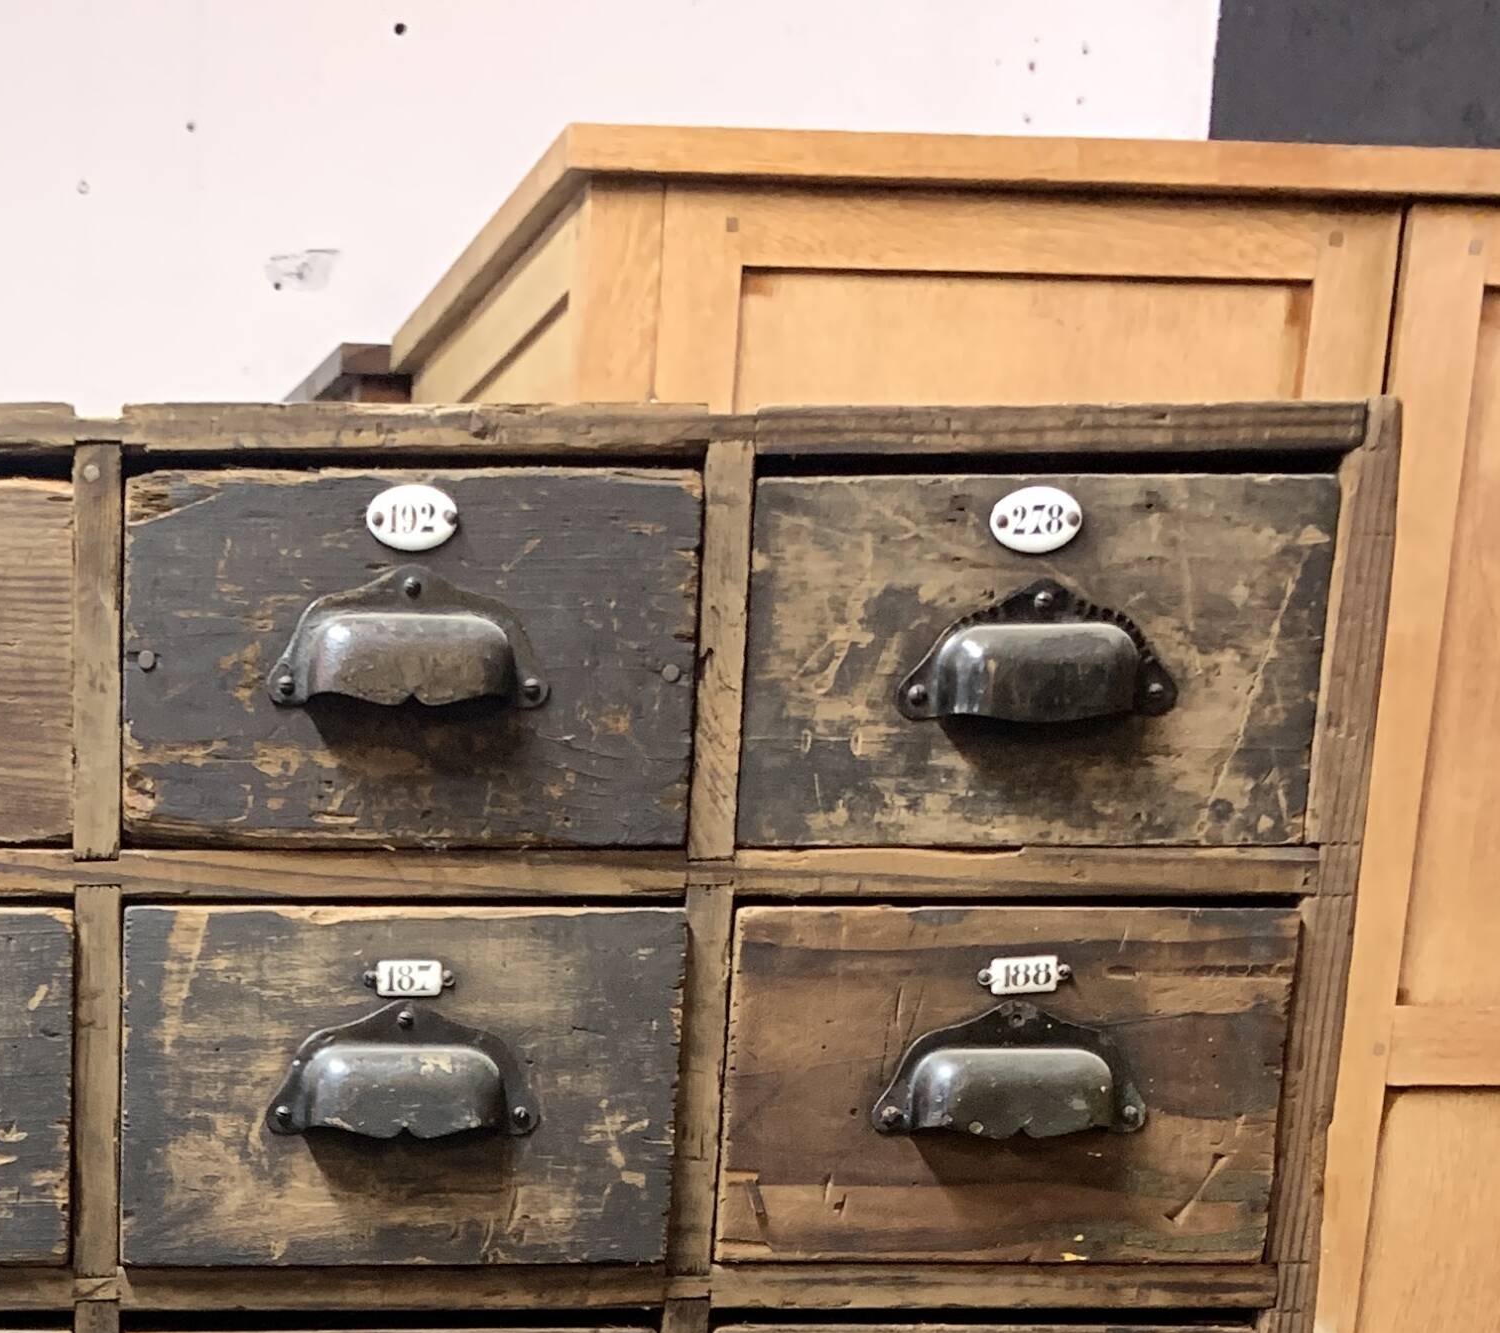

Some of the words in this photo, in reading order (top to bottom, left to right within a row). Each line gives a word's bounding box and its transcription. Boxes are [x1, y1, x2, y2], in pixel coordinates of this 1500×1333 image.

[389, 503, 435, 533] 192
[1013, 504, 1063, 535] 278
[387, 965, 433, 992] 187
[1004, 963, 1052, 988] 188
